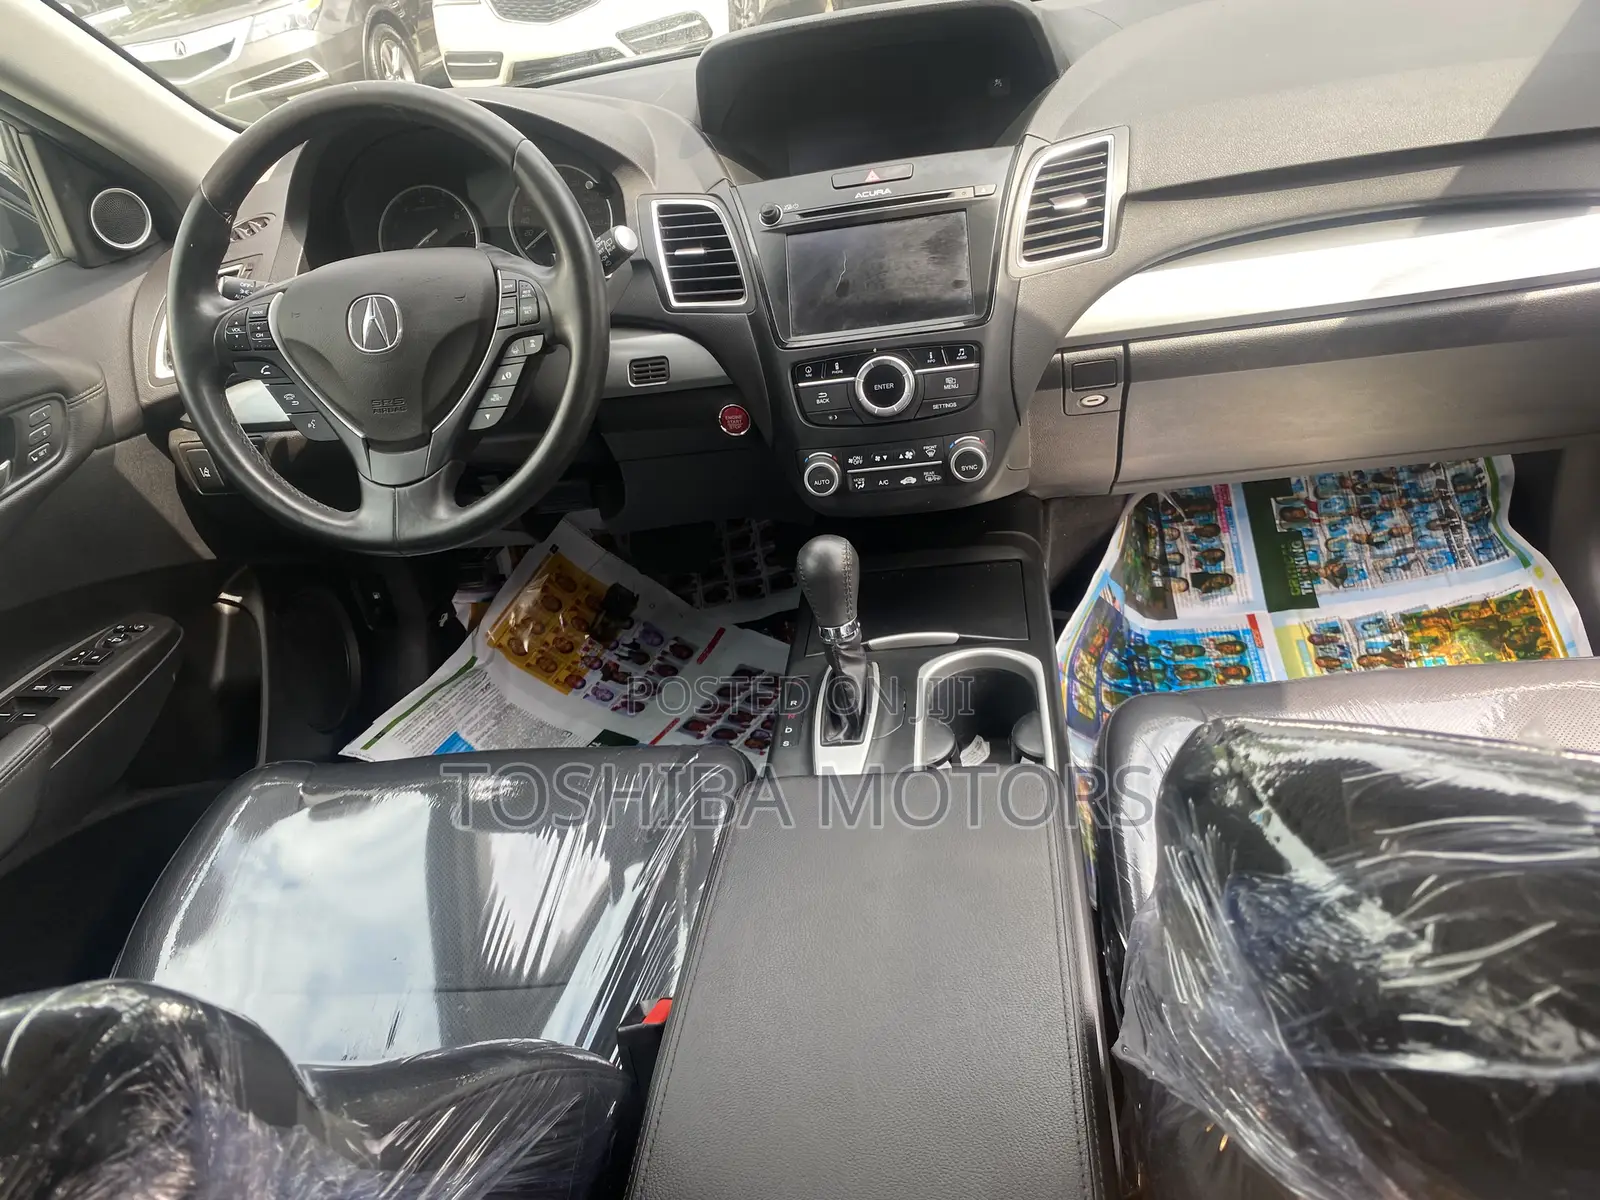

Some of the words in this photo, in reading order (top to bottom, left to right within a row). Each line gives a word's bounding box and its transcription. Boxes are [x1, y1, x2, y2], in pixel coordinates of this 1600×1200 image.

[854, 187, 892, 199] ACURA
[873, 382, 895, 391] ENTER
[932, 402, 958, 410] SETTINGS
[961, 464, 979, 472] SYNC
[813, 478, 831, 487] AUTO
